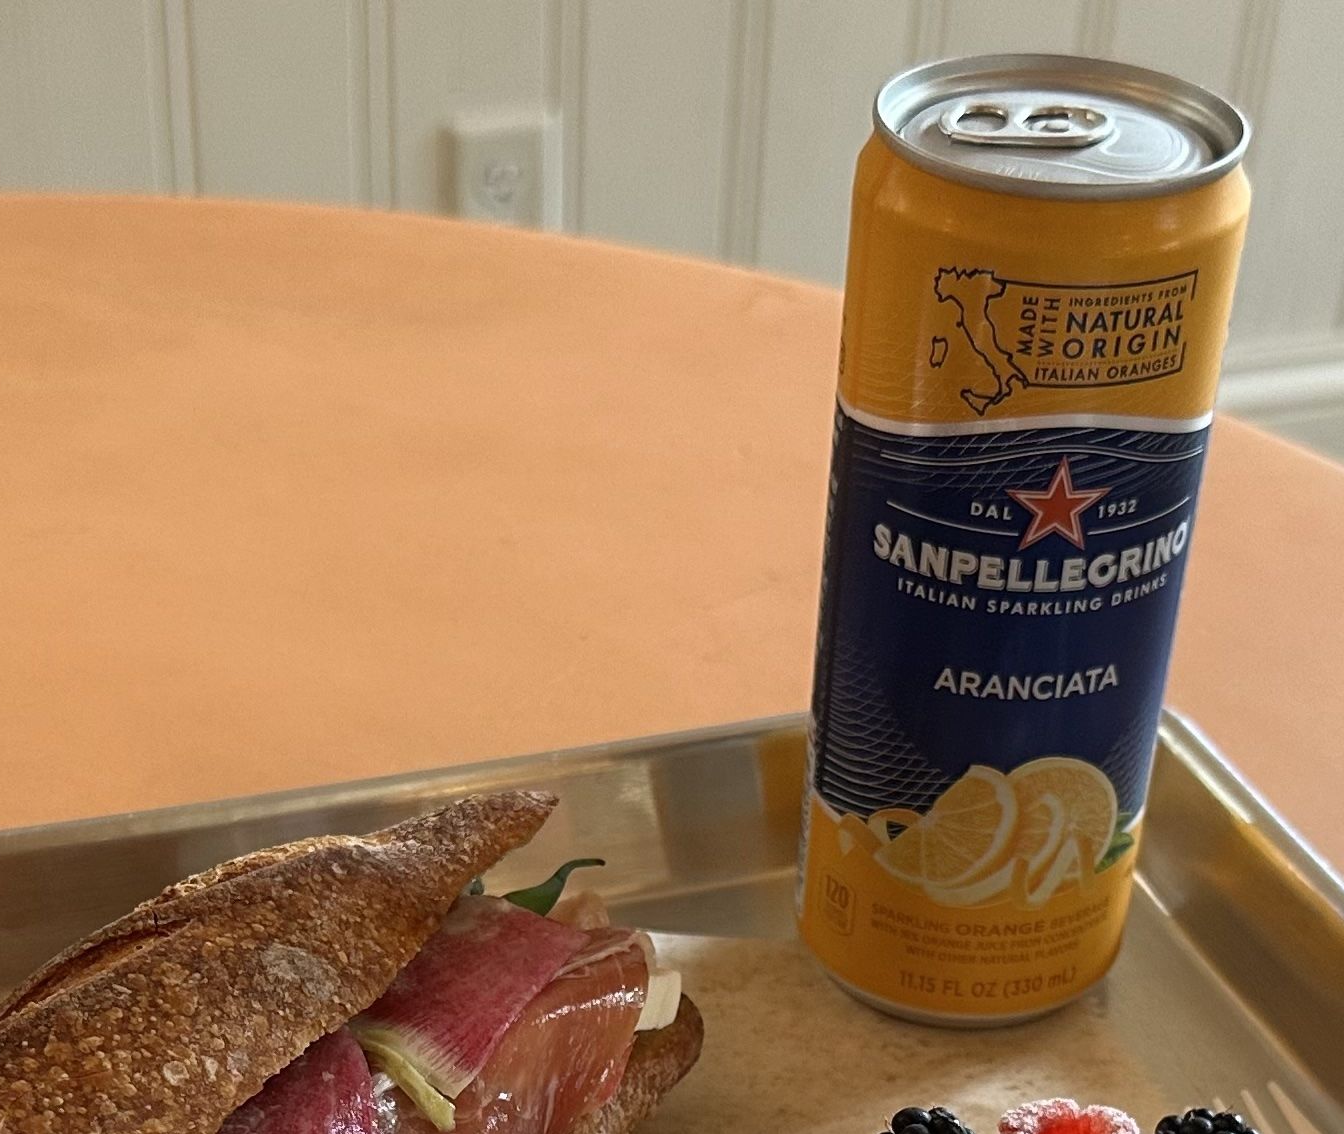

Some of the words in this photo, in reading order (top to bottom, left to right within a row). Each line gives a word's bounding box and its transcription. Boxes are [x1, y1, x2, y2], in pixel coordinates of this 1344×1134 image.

[1069, 292, 1153, 307] INGREDIENTS
[1158, 285, 1187, 300] FROM
[1016, 296, 1038, 356] MADE
[1038, 298, 1060, 357] WITH
[1066, 301, 1184, 333] NATURAL
[1062, 326, 1181, 360] ORIGIN
[1034, 368, 1099, 381] ITALIAN
[1107, 355, 1177, 378] ORANGES
[970, 501, 1013, 521] DAL
[1097, 499, 1137, 519] 1932
[873, 516, 1190, 593] SANPELLEGRINO
[898, 577, 976, 611] ITALIAN
[986, 598, 1102, 616] SPARKLING
[1111, 574, 1168, 607] DRINKS
[934, 664, 1119, 701] ARANCIATA
[825, 874, 850, 909] 120
[872, 903, 950, 934] SPARKLING
[956, 919, 1047, 938] ORANGE
[900, 969, 936, 994] 11.15
[942, 979, 963, 997] FL
[971, 981, 997, 999] OZ
[1003, 974, 1043, 999] (330
[1048, 966, 1077, 988] mL)
